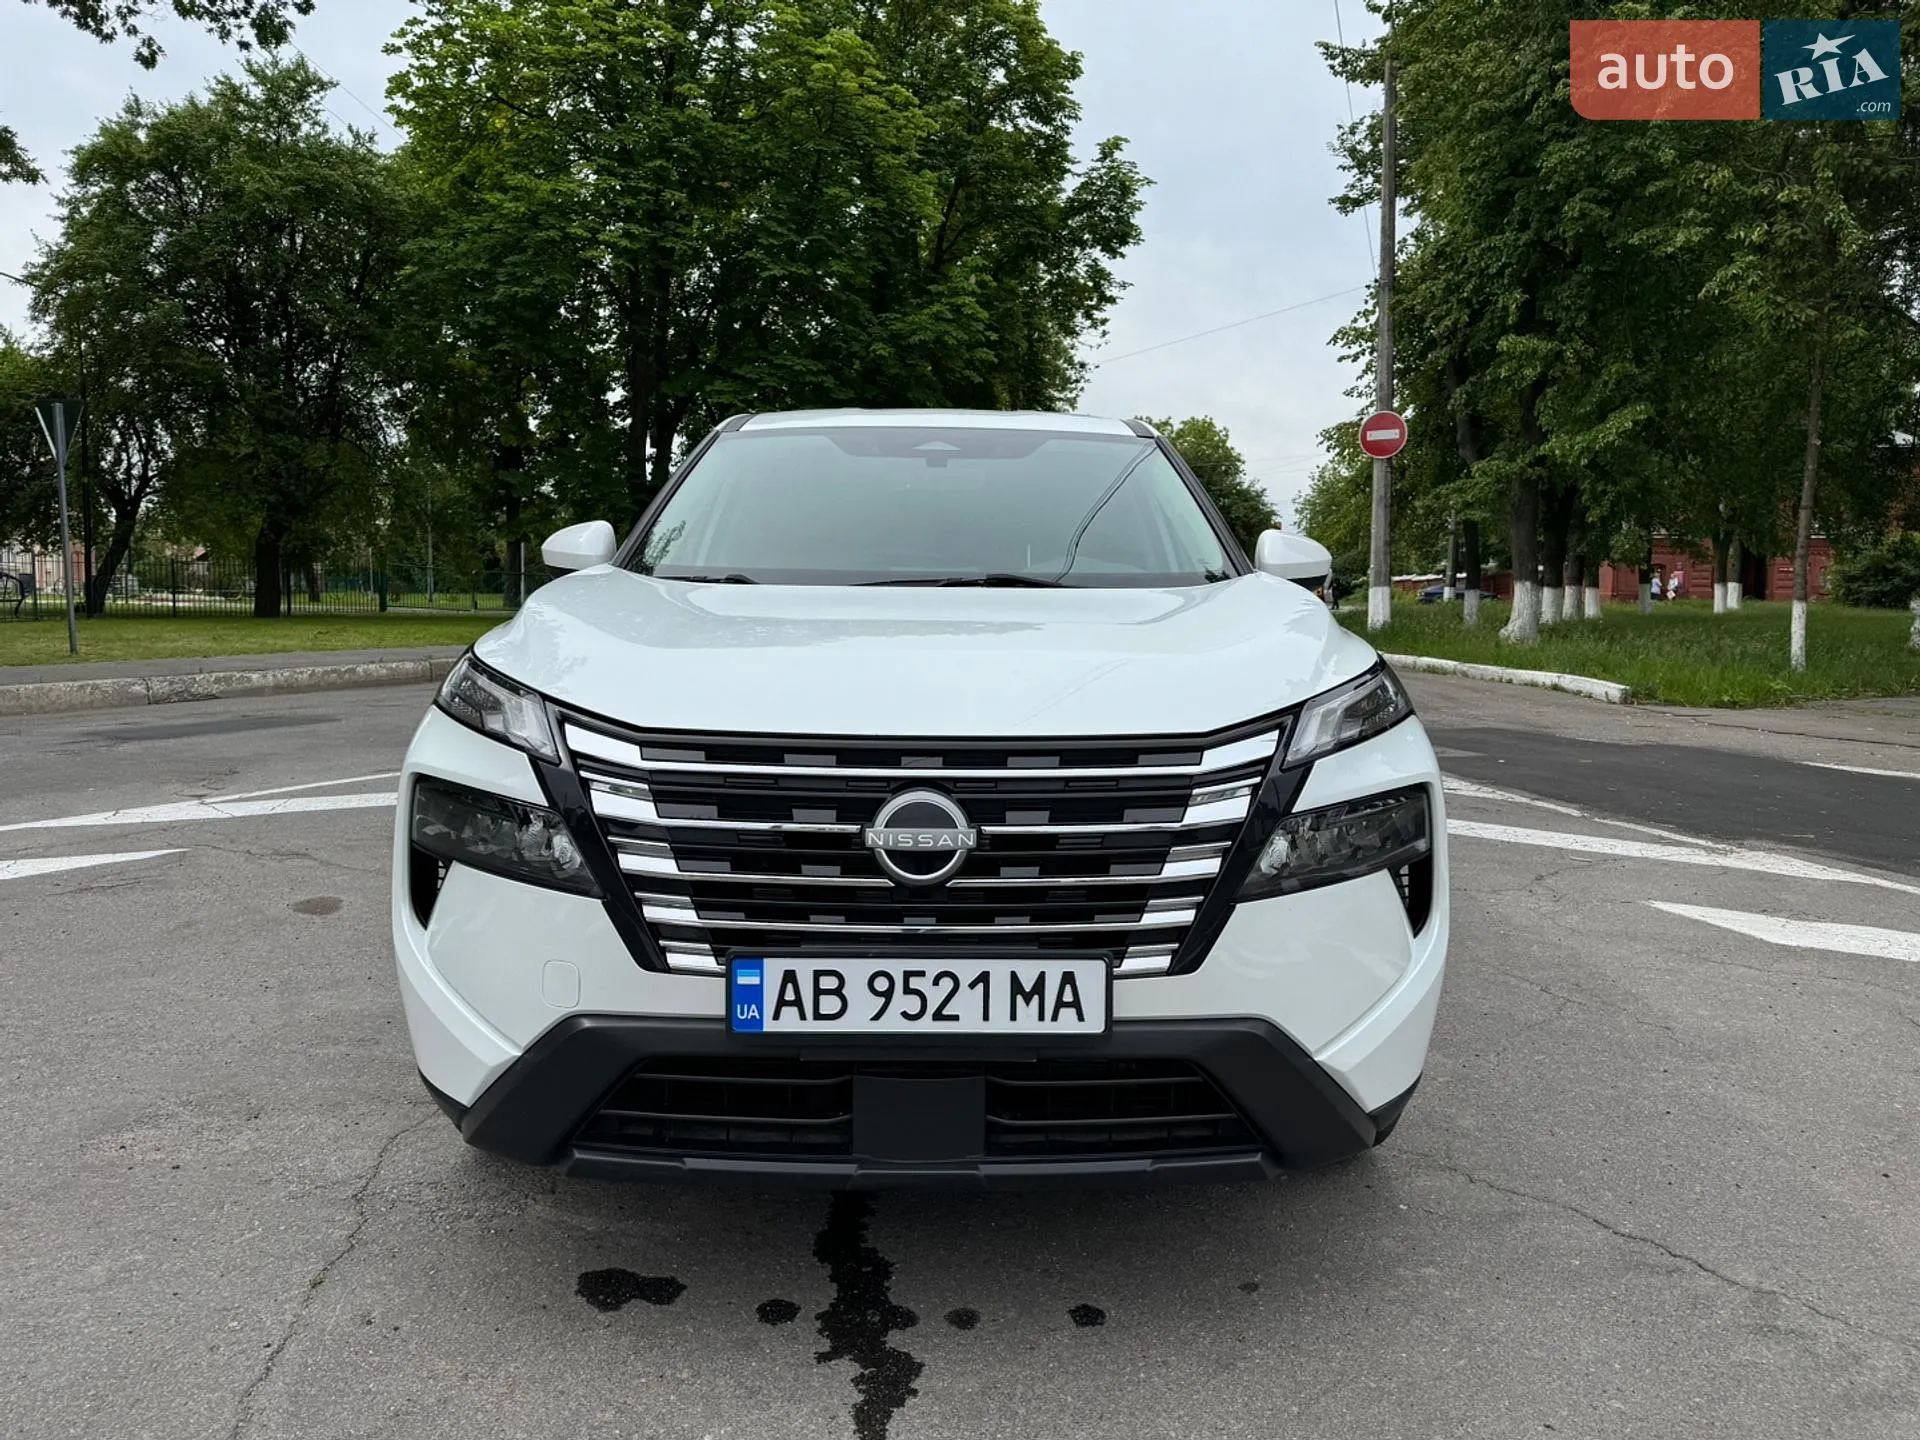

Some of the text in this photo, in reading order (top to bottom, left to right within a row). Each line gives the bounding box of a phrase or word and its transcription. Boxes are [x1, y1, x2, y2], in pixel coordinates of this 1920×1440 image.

[868, 832, 974, 847] NISSAN
[772, 969, 1085, 1022] AB 9521 MA
[736, 1003, 760, 1020] UA
